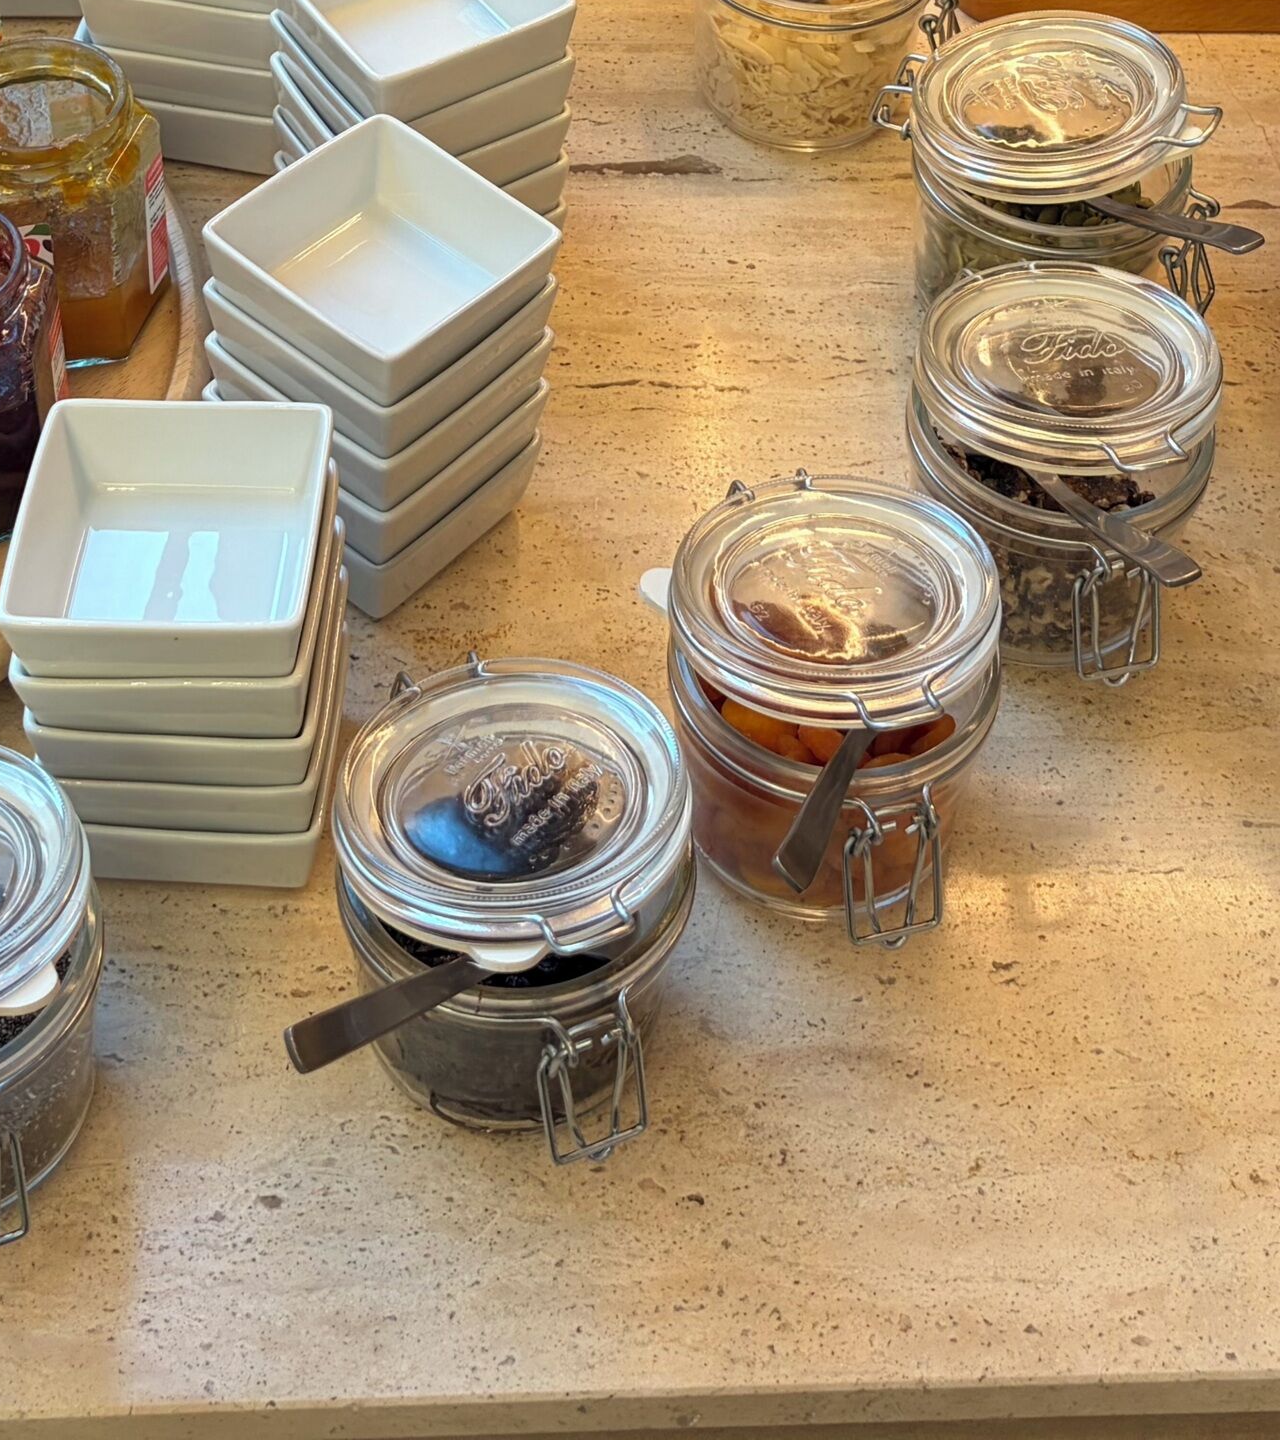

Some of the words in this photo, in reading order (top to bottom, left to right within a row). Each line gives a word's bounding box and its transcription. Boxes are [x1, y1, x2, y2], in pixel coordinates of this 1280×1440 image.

[1020, 329, 1127, 365] Fido
[1078, 367, 1095, 377] in
[1101, 364, 1136, 377] Italy
[463, 740, 568, 828] Fido
